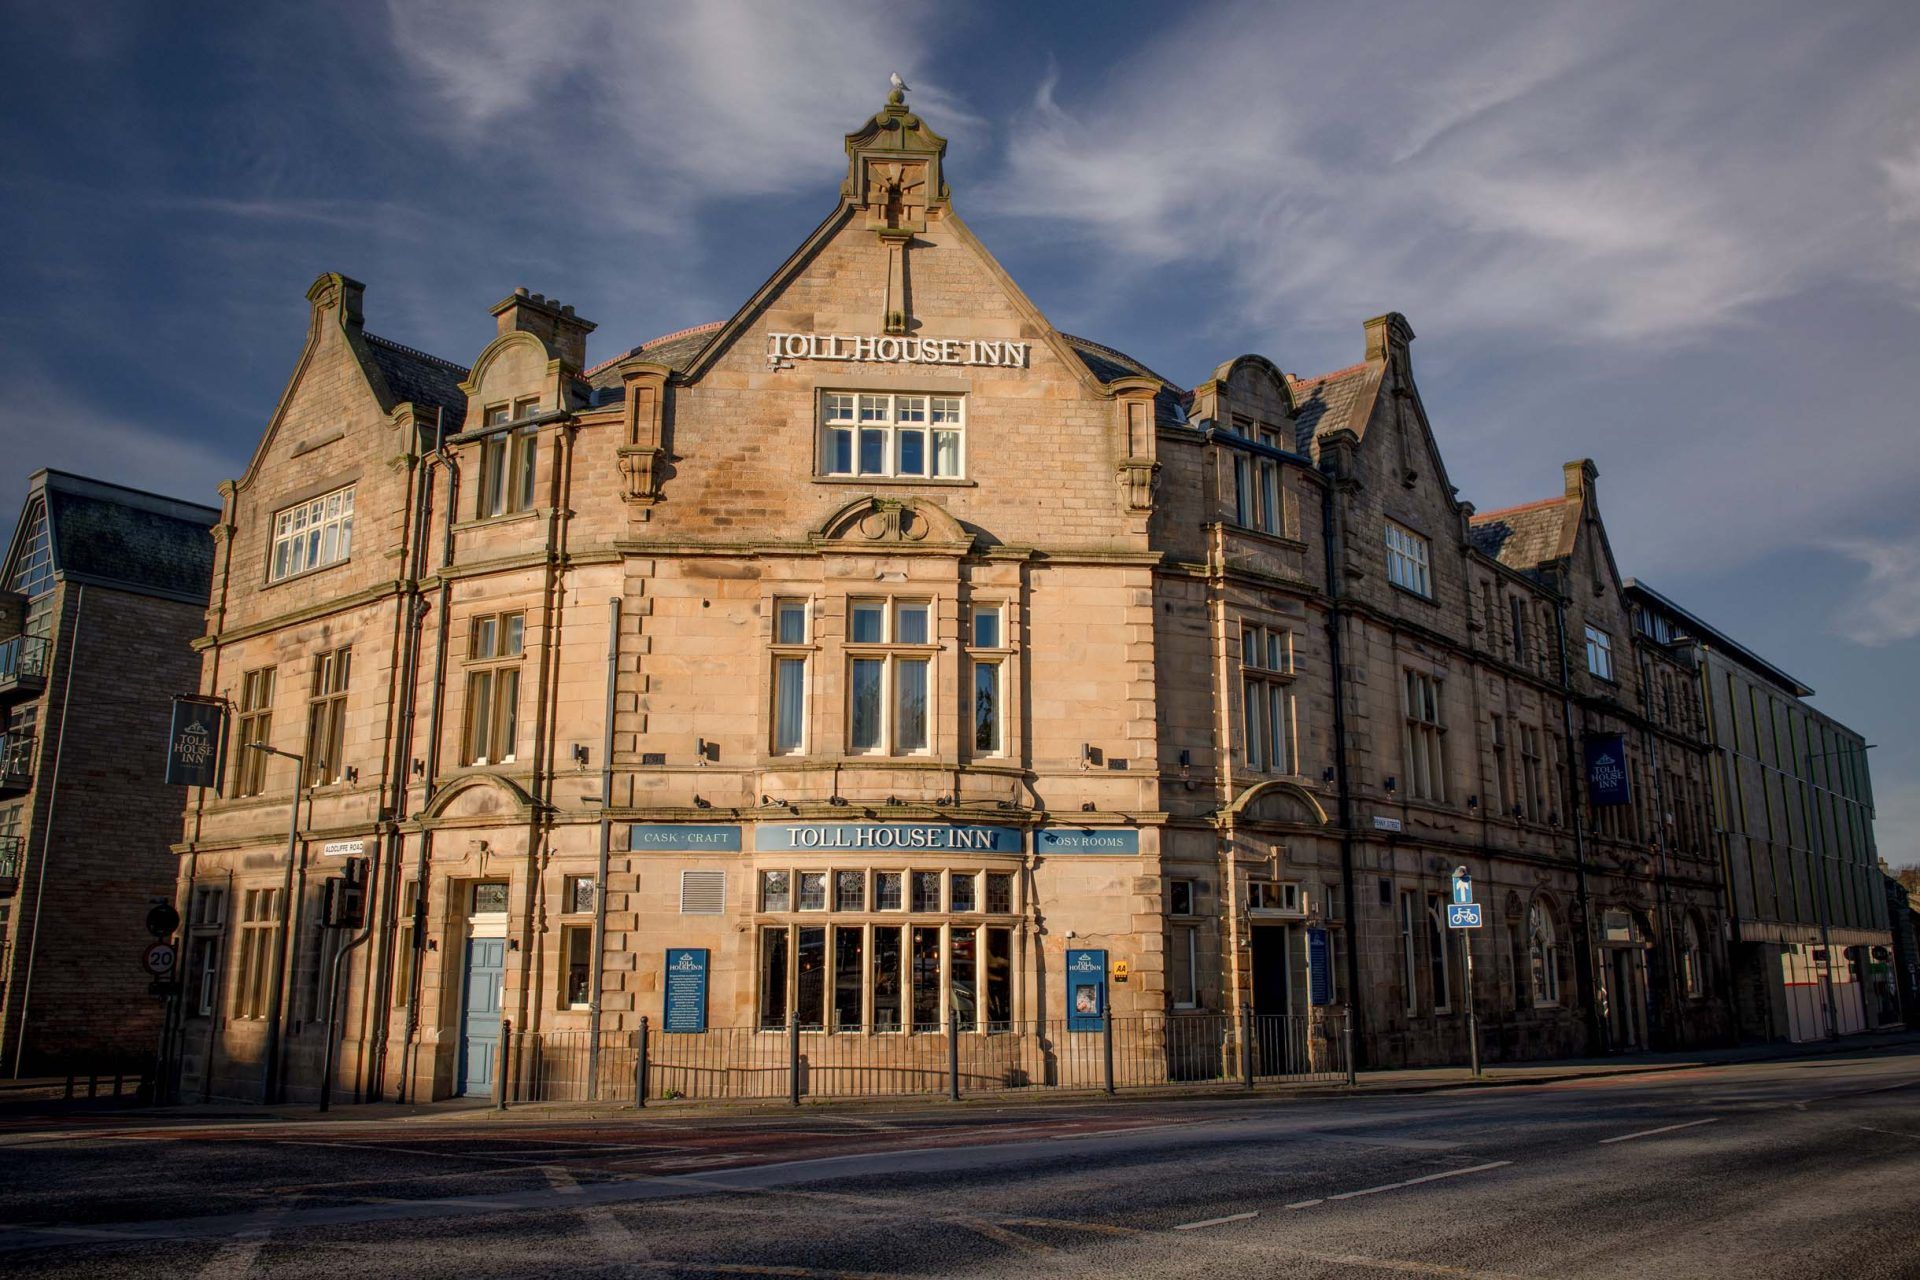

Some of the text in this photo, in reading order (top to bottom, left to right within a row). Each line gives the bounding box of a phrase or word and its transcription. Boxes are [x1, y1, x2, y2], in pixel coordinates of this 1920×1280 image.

[768, 332, 1025, 367] TOLL HOUSE INN
[180, 734, 210, 746] TOLL
[174, 742, 214, 756] HOUSE
[182, 753, 204, 764] INN
[1593, 765, 1619, 775] TOLL
[1591, 771, 1624, 783] HOUSE
[1599, 780, 1617, 789] INN
[644, 832, 729, 843] CASK CRAFT
[786, 828, 993, 849] TOLL HOUSE INN
[1048, 836, 1124, 847] COSY ROOMS
[150, 951, 172, 966] 20
